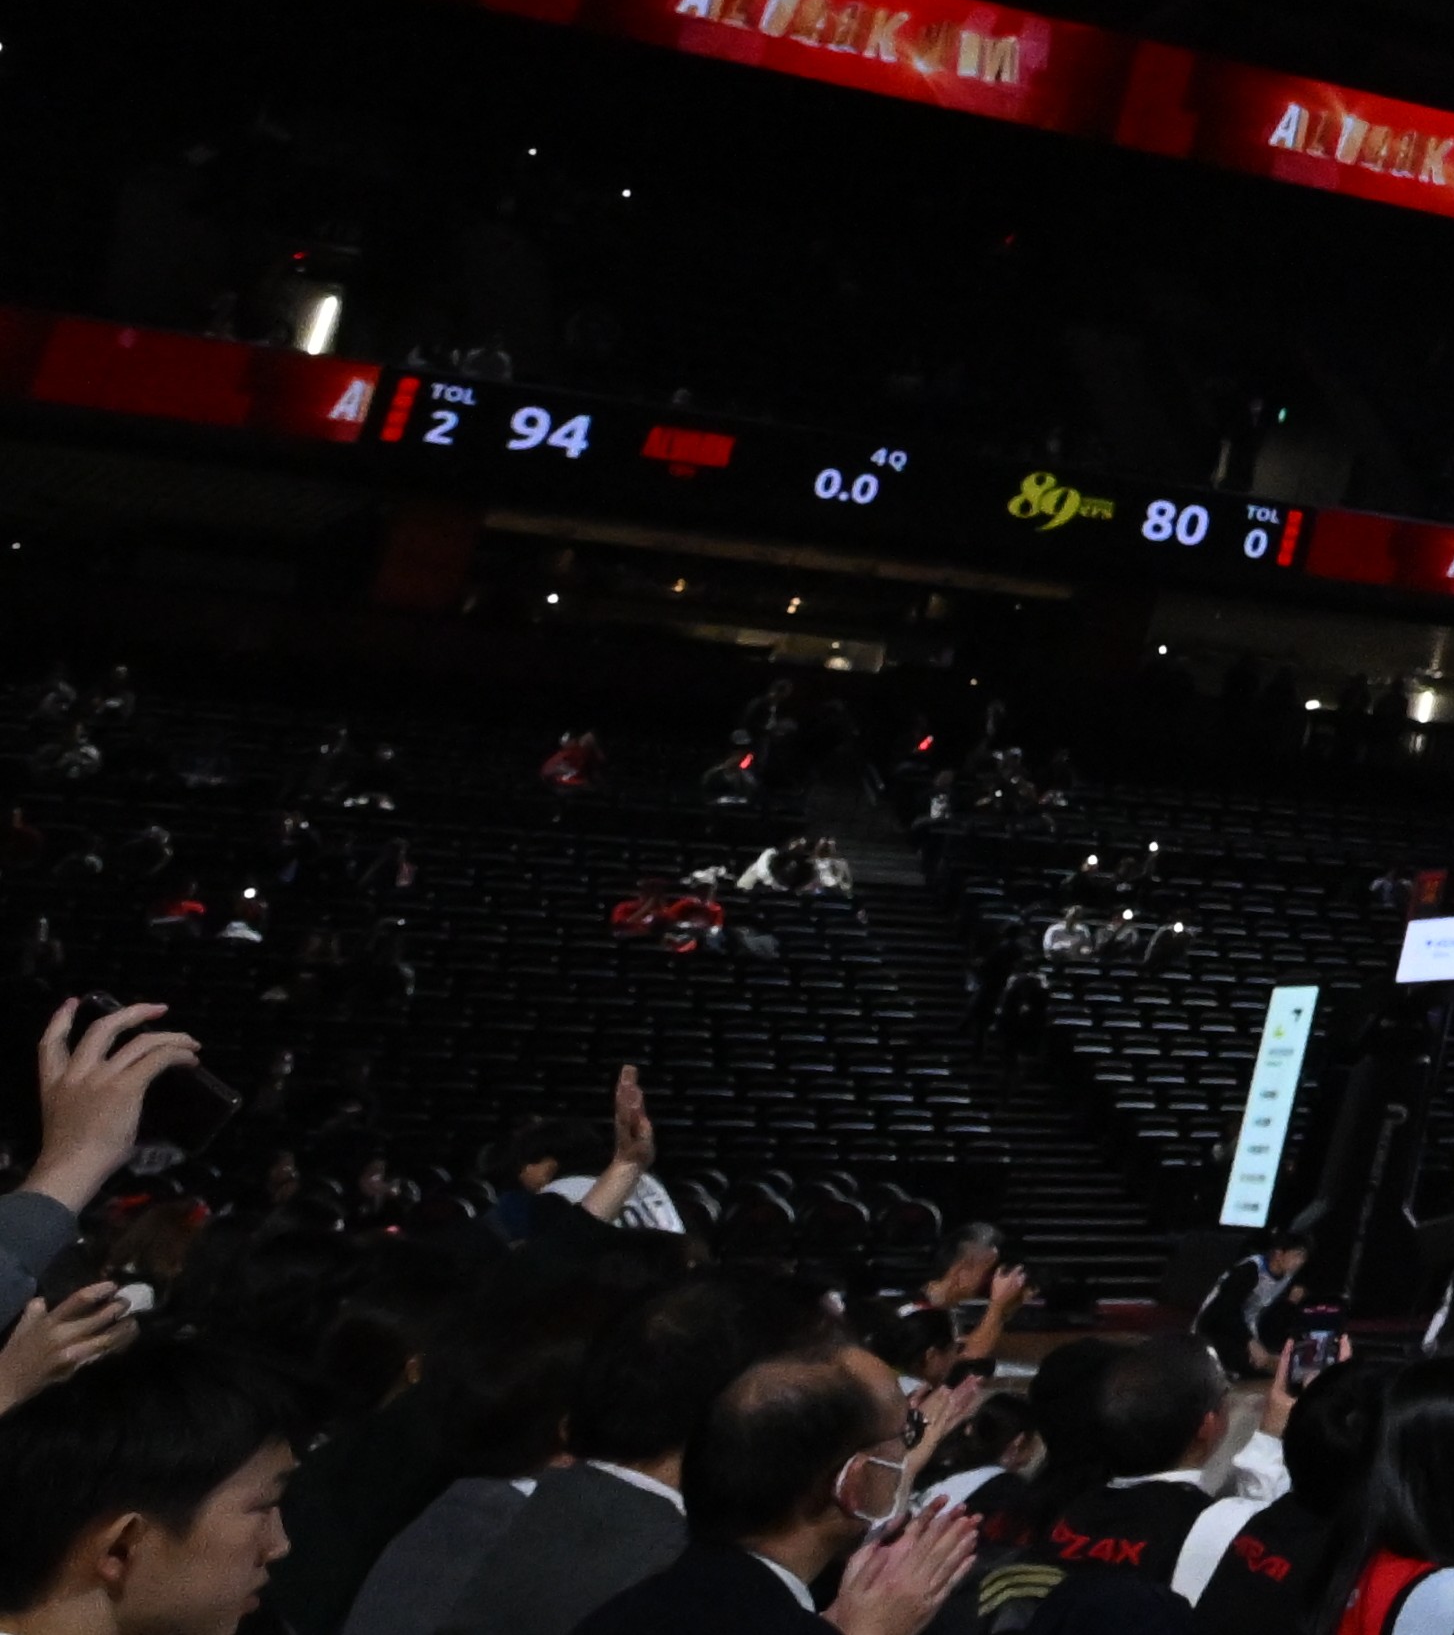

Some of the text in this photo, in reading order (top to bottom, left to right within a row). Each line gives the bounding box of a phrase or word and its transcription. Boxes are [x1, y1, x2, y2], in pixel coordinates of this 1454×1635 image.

[431, 382, 478, 407] TOL
[422, 409, 460, 446] 2
[506, 404, 592, 459] 94
[869, 447, 908, 471] 4Q
[814, 467, 880, 505] 0.0
[1141, 498, 1211, 547] 80
[1246, 503, 1281, 525] TOL
[1243, 527, 1269, 560] 0
